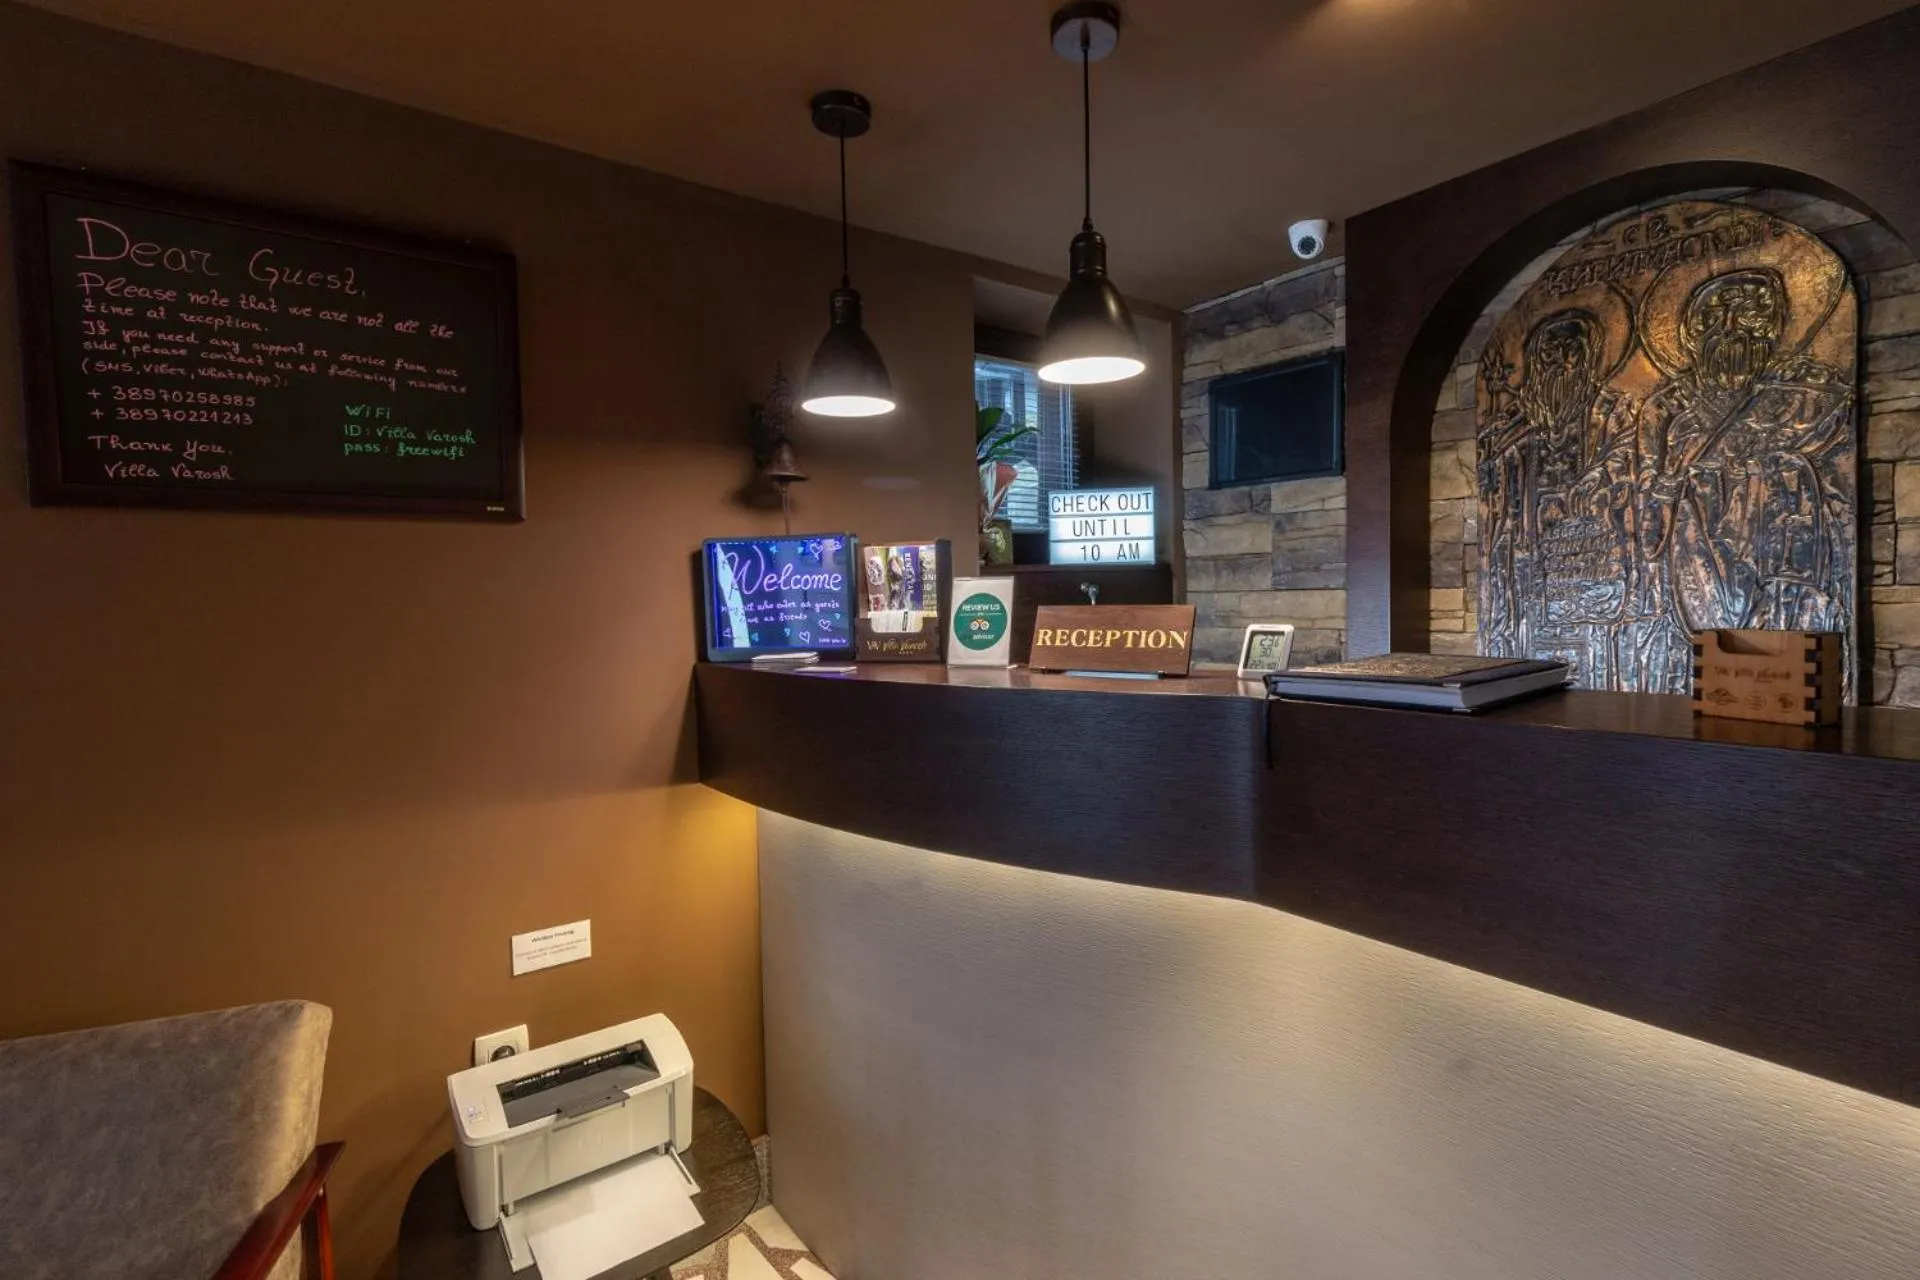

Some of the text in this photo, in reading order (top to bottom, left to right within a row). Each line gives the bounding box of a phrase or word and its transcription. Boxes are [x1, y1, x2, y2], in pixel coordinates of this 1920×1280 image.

[76, 217, 221, 276] Dear
[76, 271, 455, 339] Please note that we are not all the
[82, 298, 269, 332] time at reception.
[122, 329, 151, 343] you
[156, 332, 200, 345] need
[208, 338, 240, 355] any
[252, 342, 305, 356] support
[313, 349, 329, 358] or
[339, 352, 387, 367] service
[394, 357, 428, 372] from
[131, 343, 188, 360] please
[199, 351, 264, 367] contact
[274, 360, 293, 370] us
[299, 362, 318, 374] at
[87, 433, 174, 453] Thank
[104, 461, 236, 481] Villa Varosh
[1051, 492, 1153, 513] CHECK OUT
[1073, 517, 1132, 537] UNTIL
[1080, 542, 1141, 561] 10 AM
[725, 545, 843, 595] Welcome
[1036, 628, 1188, 650] RECEPTION
